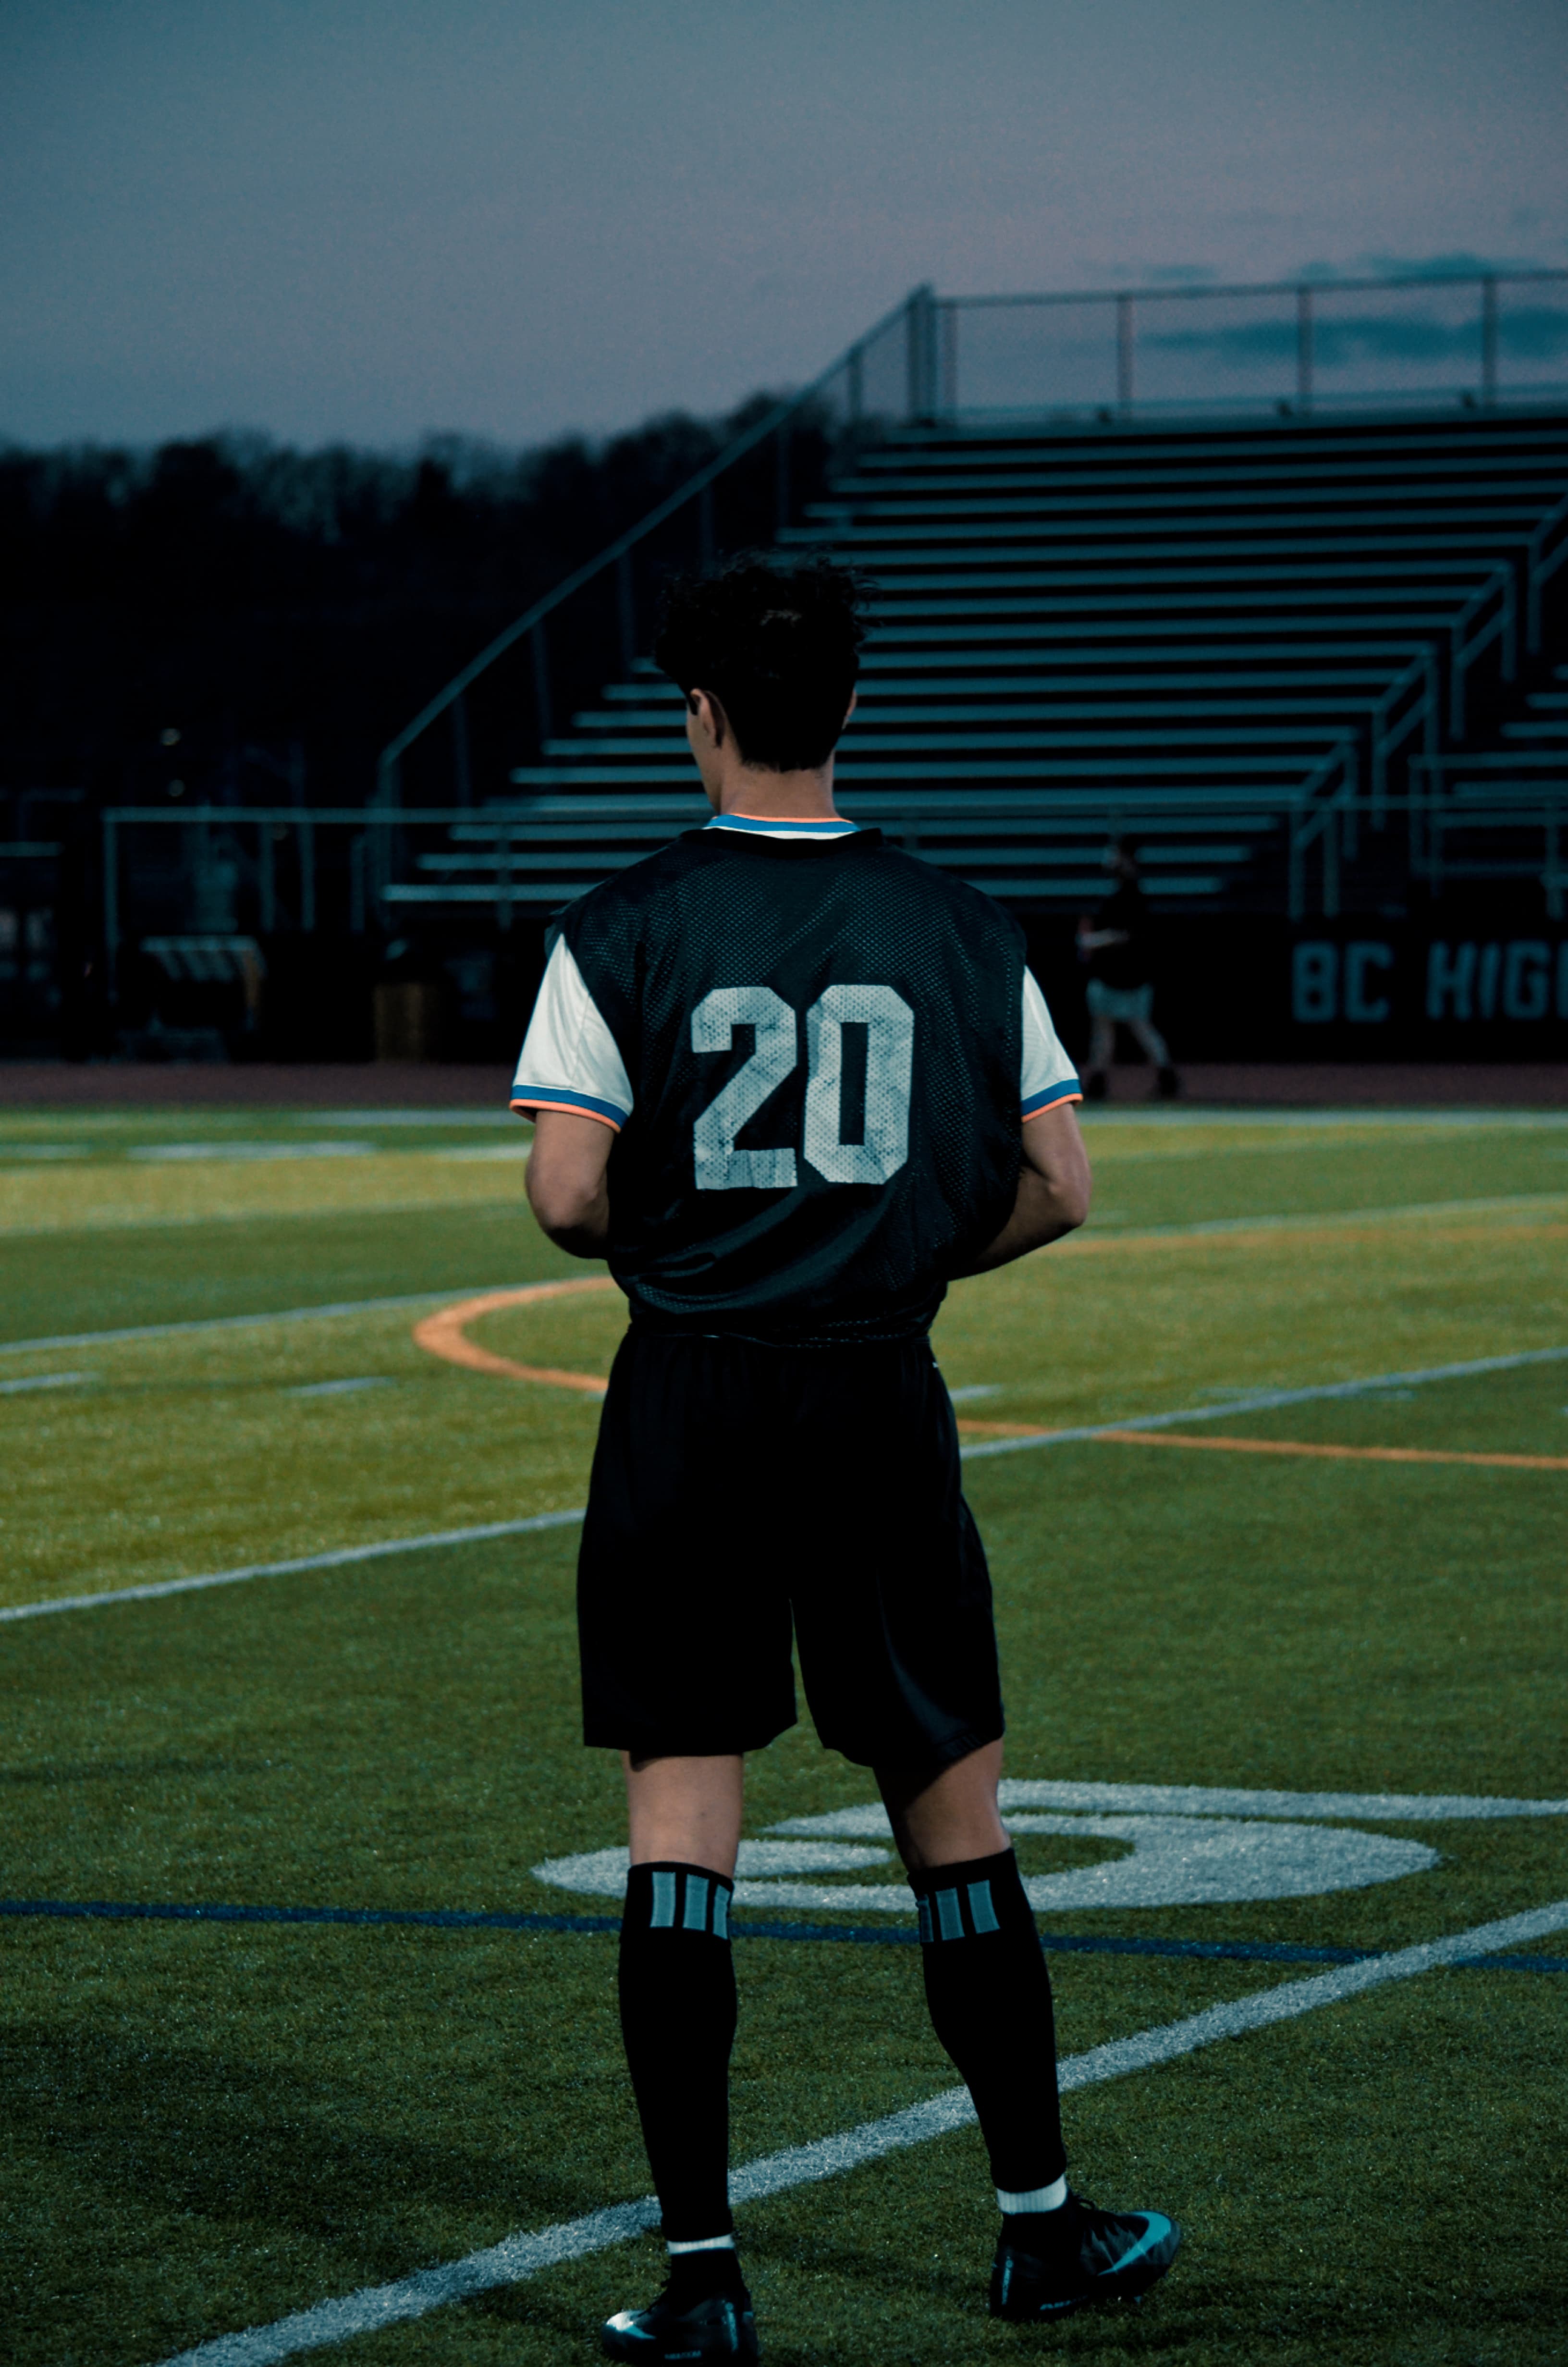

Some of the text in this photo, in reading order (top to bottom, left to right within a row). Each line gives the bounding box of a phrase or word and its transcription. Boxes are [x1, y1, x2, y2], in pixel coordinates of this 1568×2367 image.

[1291, 937, 1568, 1024] BC HIG
[691, 984, 915, 1190] 20
